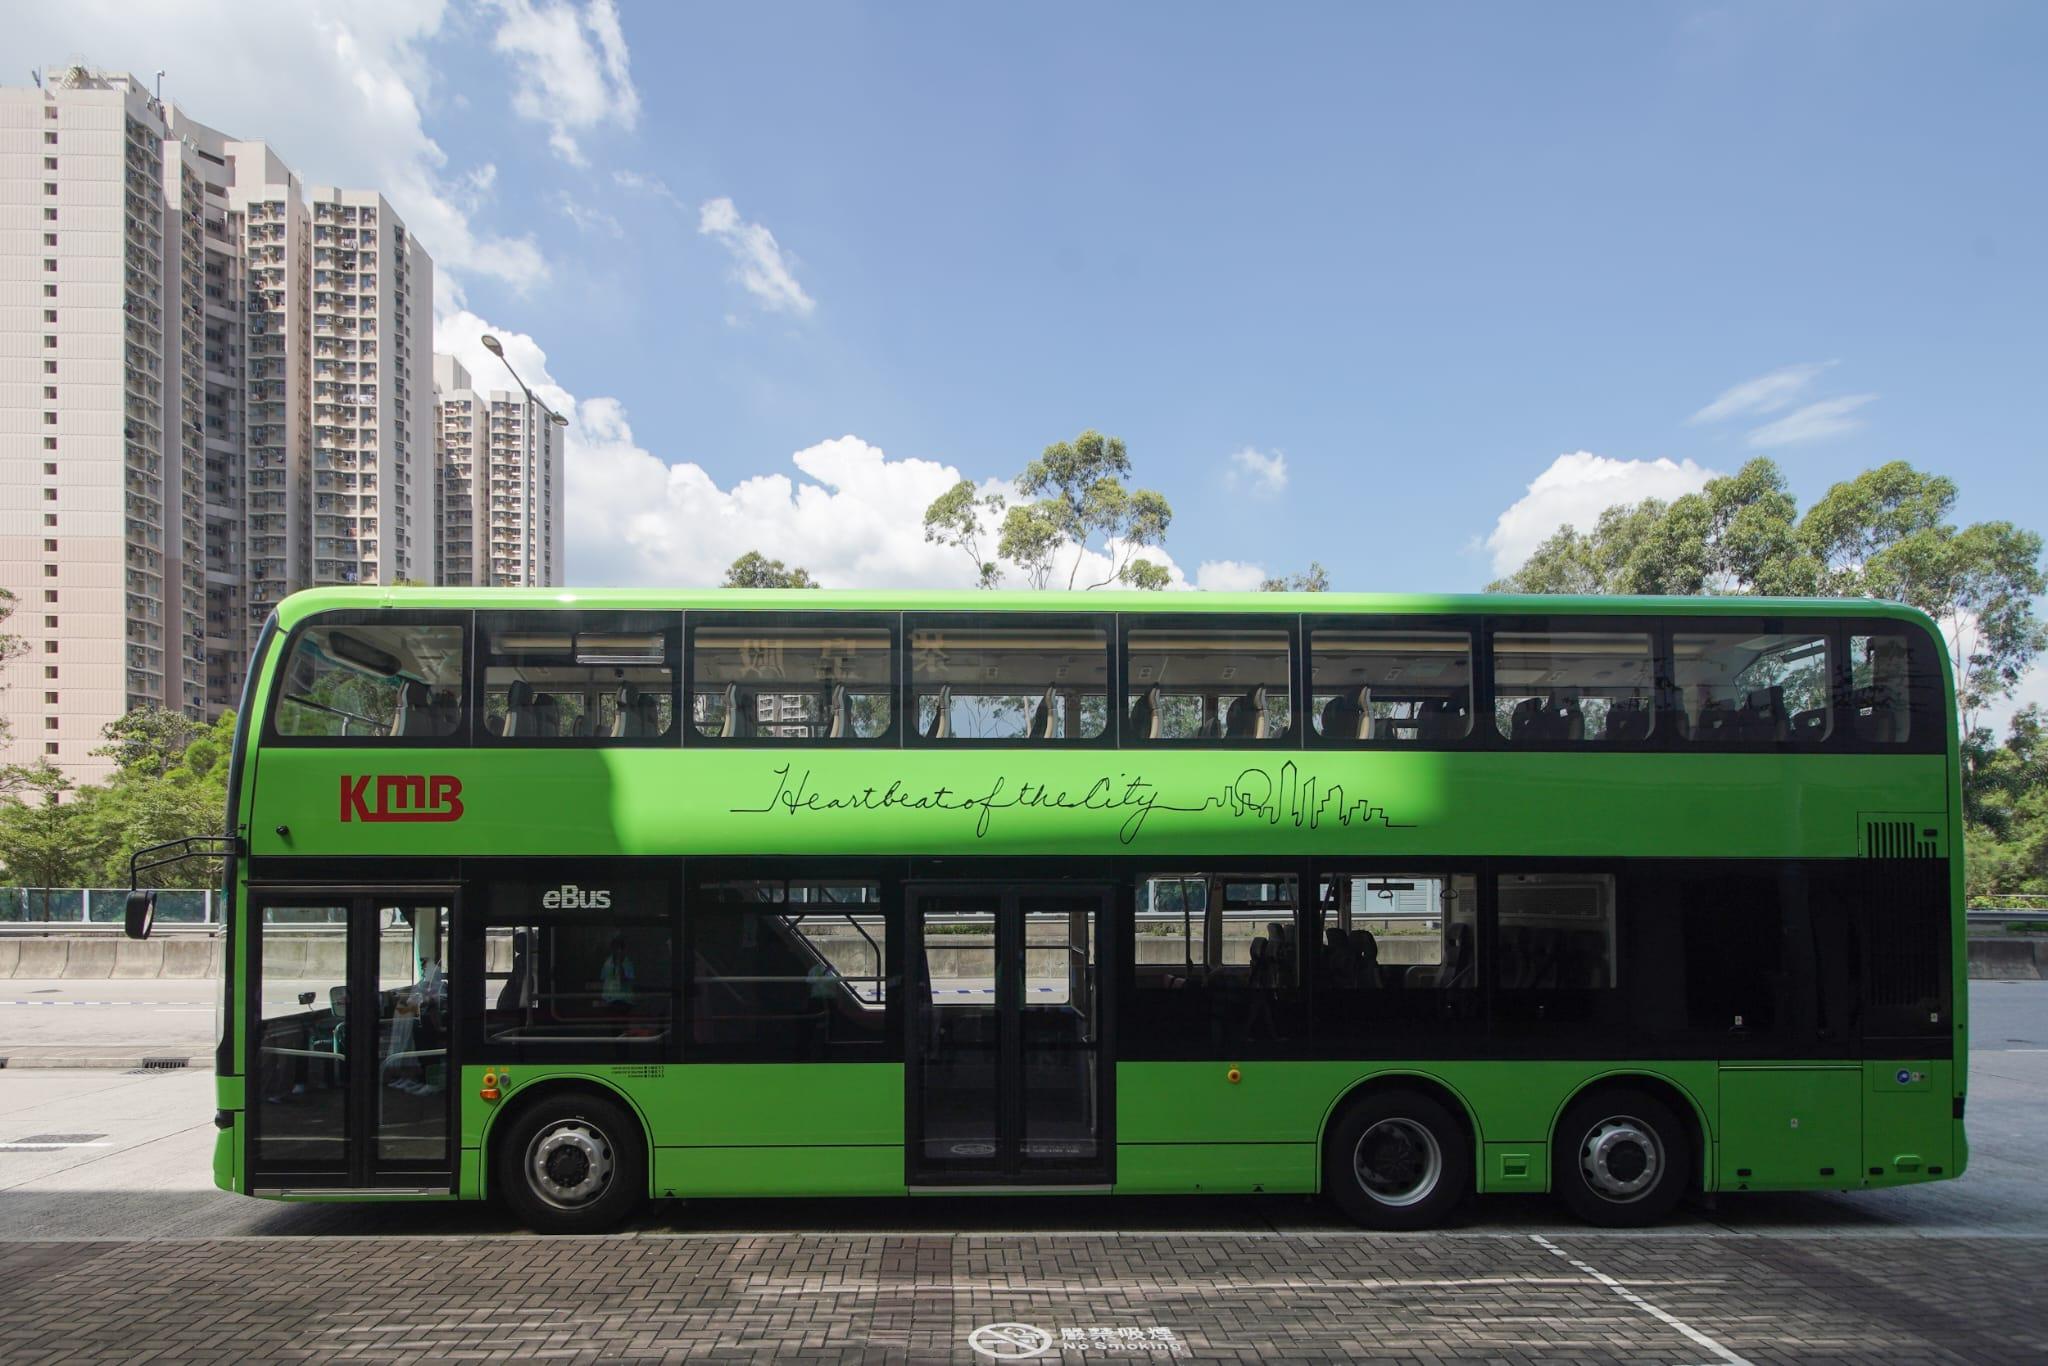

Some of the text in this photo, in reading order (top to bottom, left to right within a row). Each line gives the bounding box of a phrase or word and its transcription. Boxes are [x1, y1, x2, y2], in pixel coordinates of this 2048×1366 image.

[339, 774, 465, 823] KMB
[772, 762, 1158, 845] Heartbeat of the City
[542, 884, 611, 909] eBus
[1062, 1341, 1182, 1352] No Smoking
